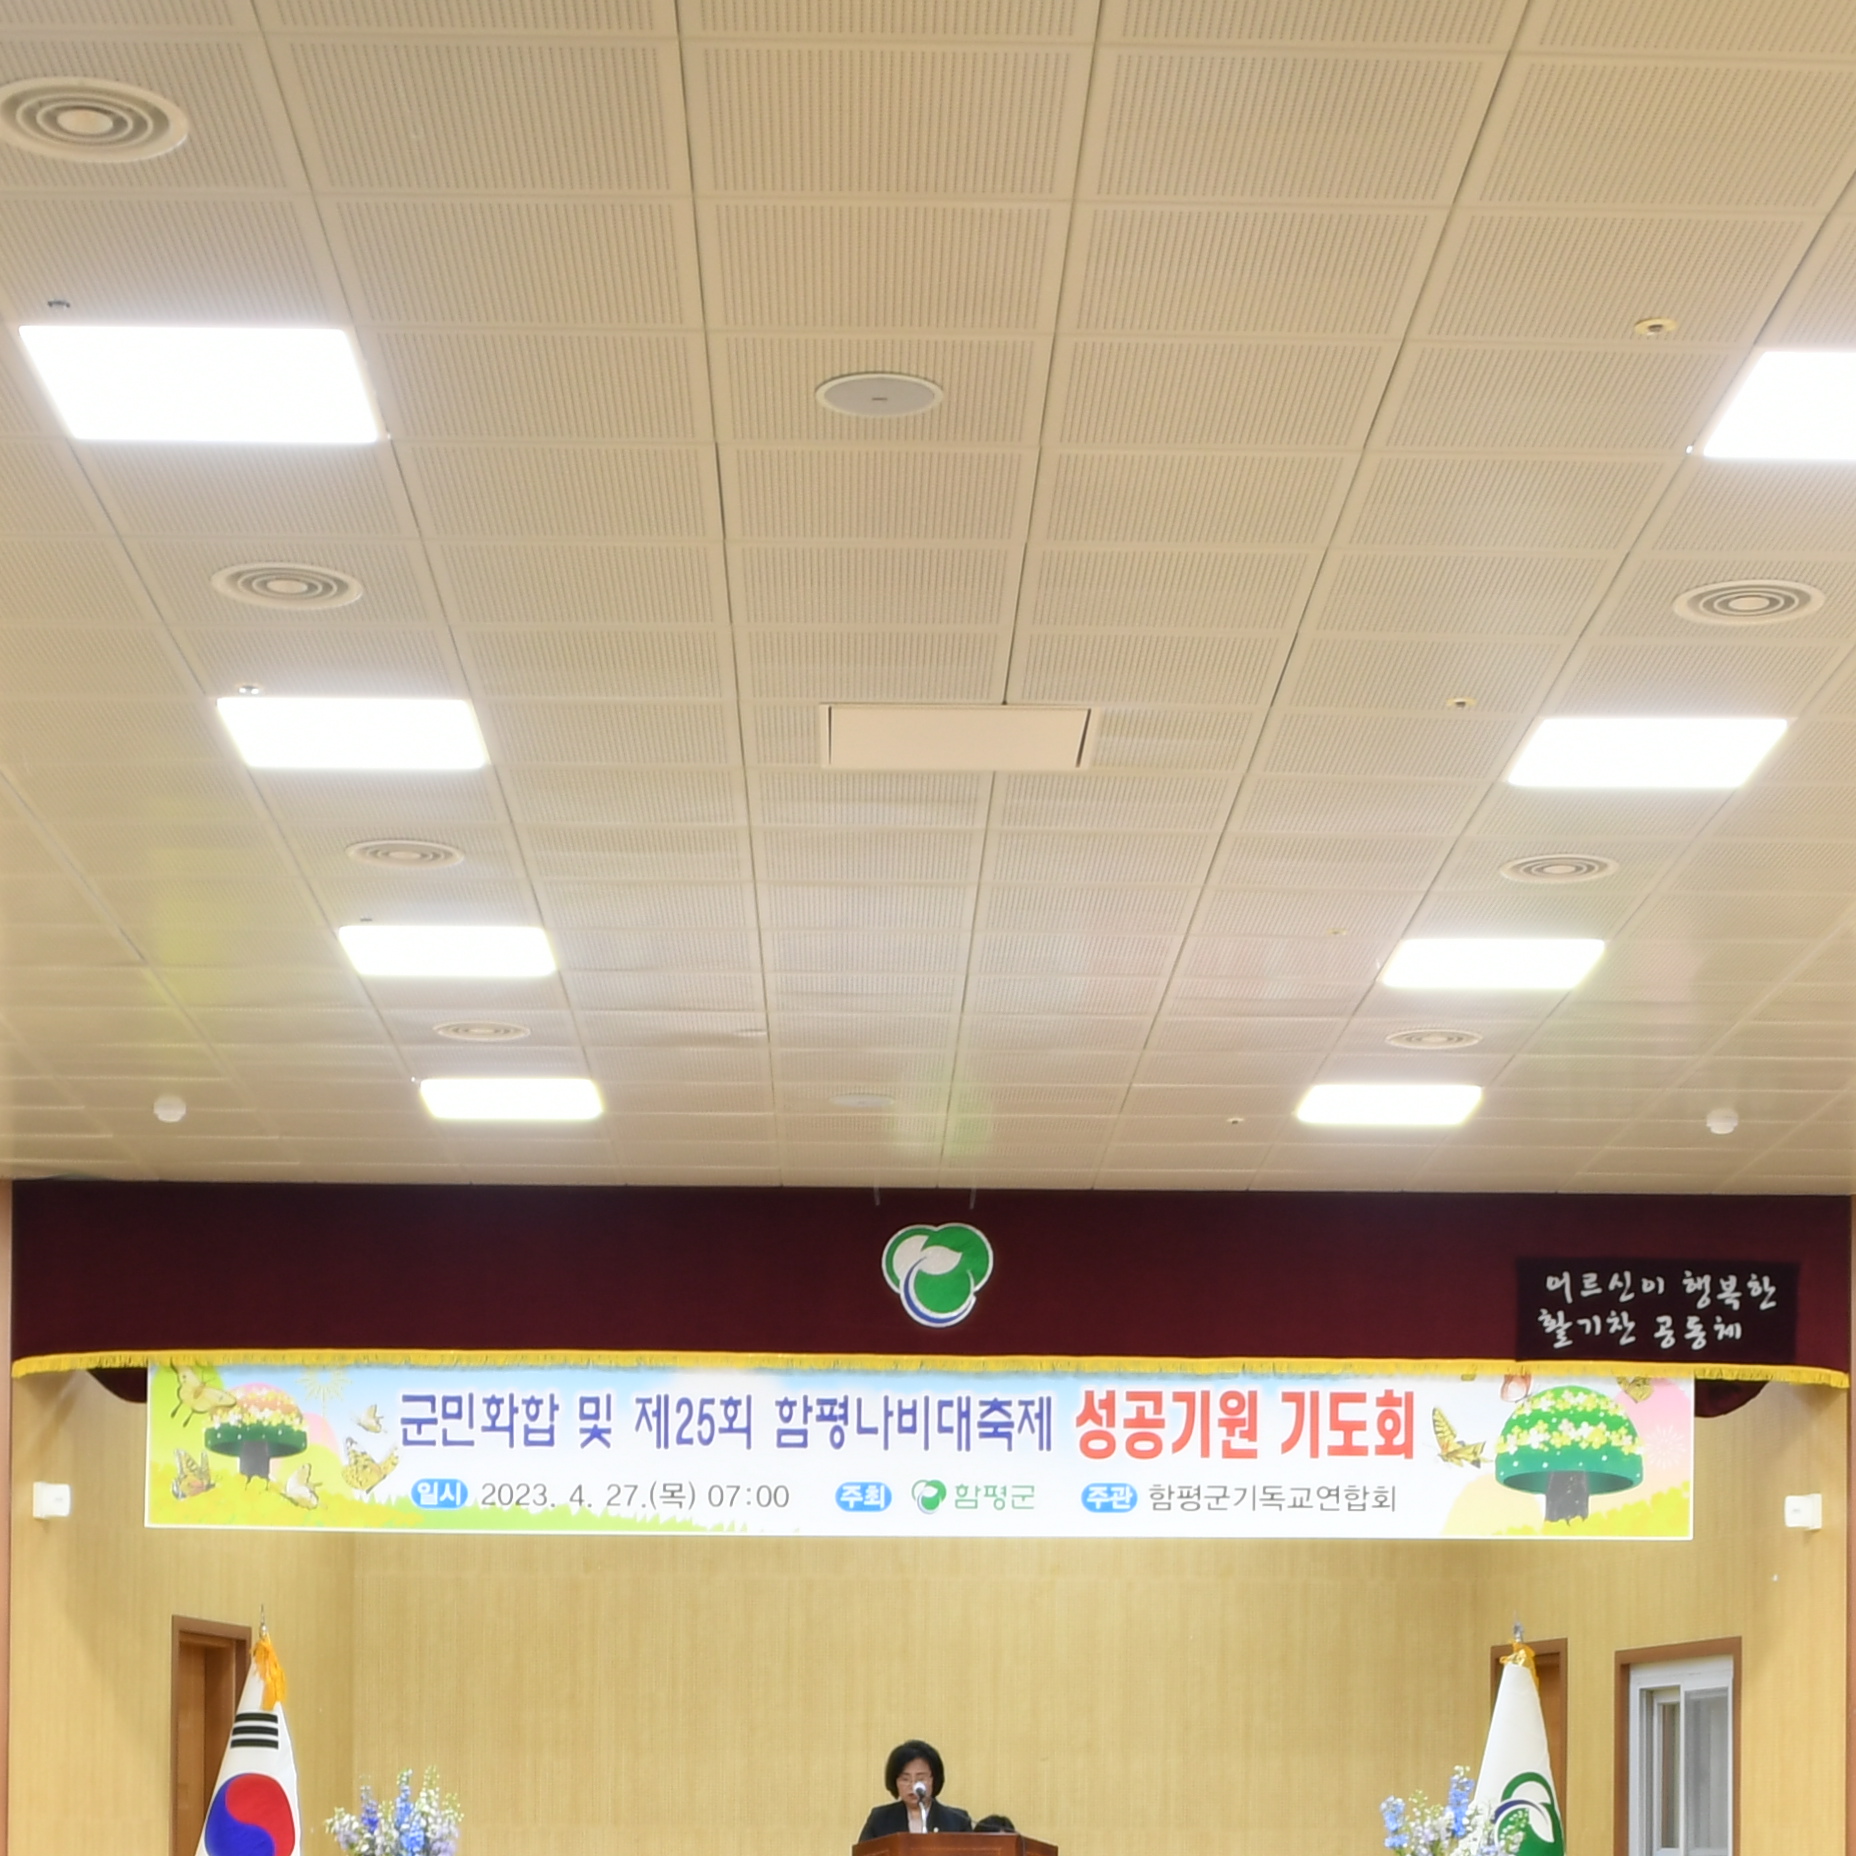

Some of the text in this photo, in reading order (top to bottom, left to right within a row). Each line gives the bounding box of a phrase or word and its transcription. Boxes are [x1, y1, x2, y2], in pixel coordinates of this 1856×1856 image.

[1545, 1270, 1777, 1310] 어르신이 행복한
[1537, 1308, 1742, 1350] 활기찬 공동체
[400, 1389, 1414, 1460] 군민화합 및 제25회 함평나비대축제 성공기원 기도회
[416, 1480, 463, 1507] 일시
[480, 1482, 557, 1508] 2023.
[569, 1483, 593, 1508] 4.
[707, 1484, 790, 1508] 07:00
[839, 1483, 1036, 1511] 주최 함평군
[1086, 1483, 1397, 1512] 주관 함평군기독교연합회
